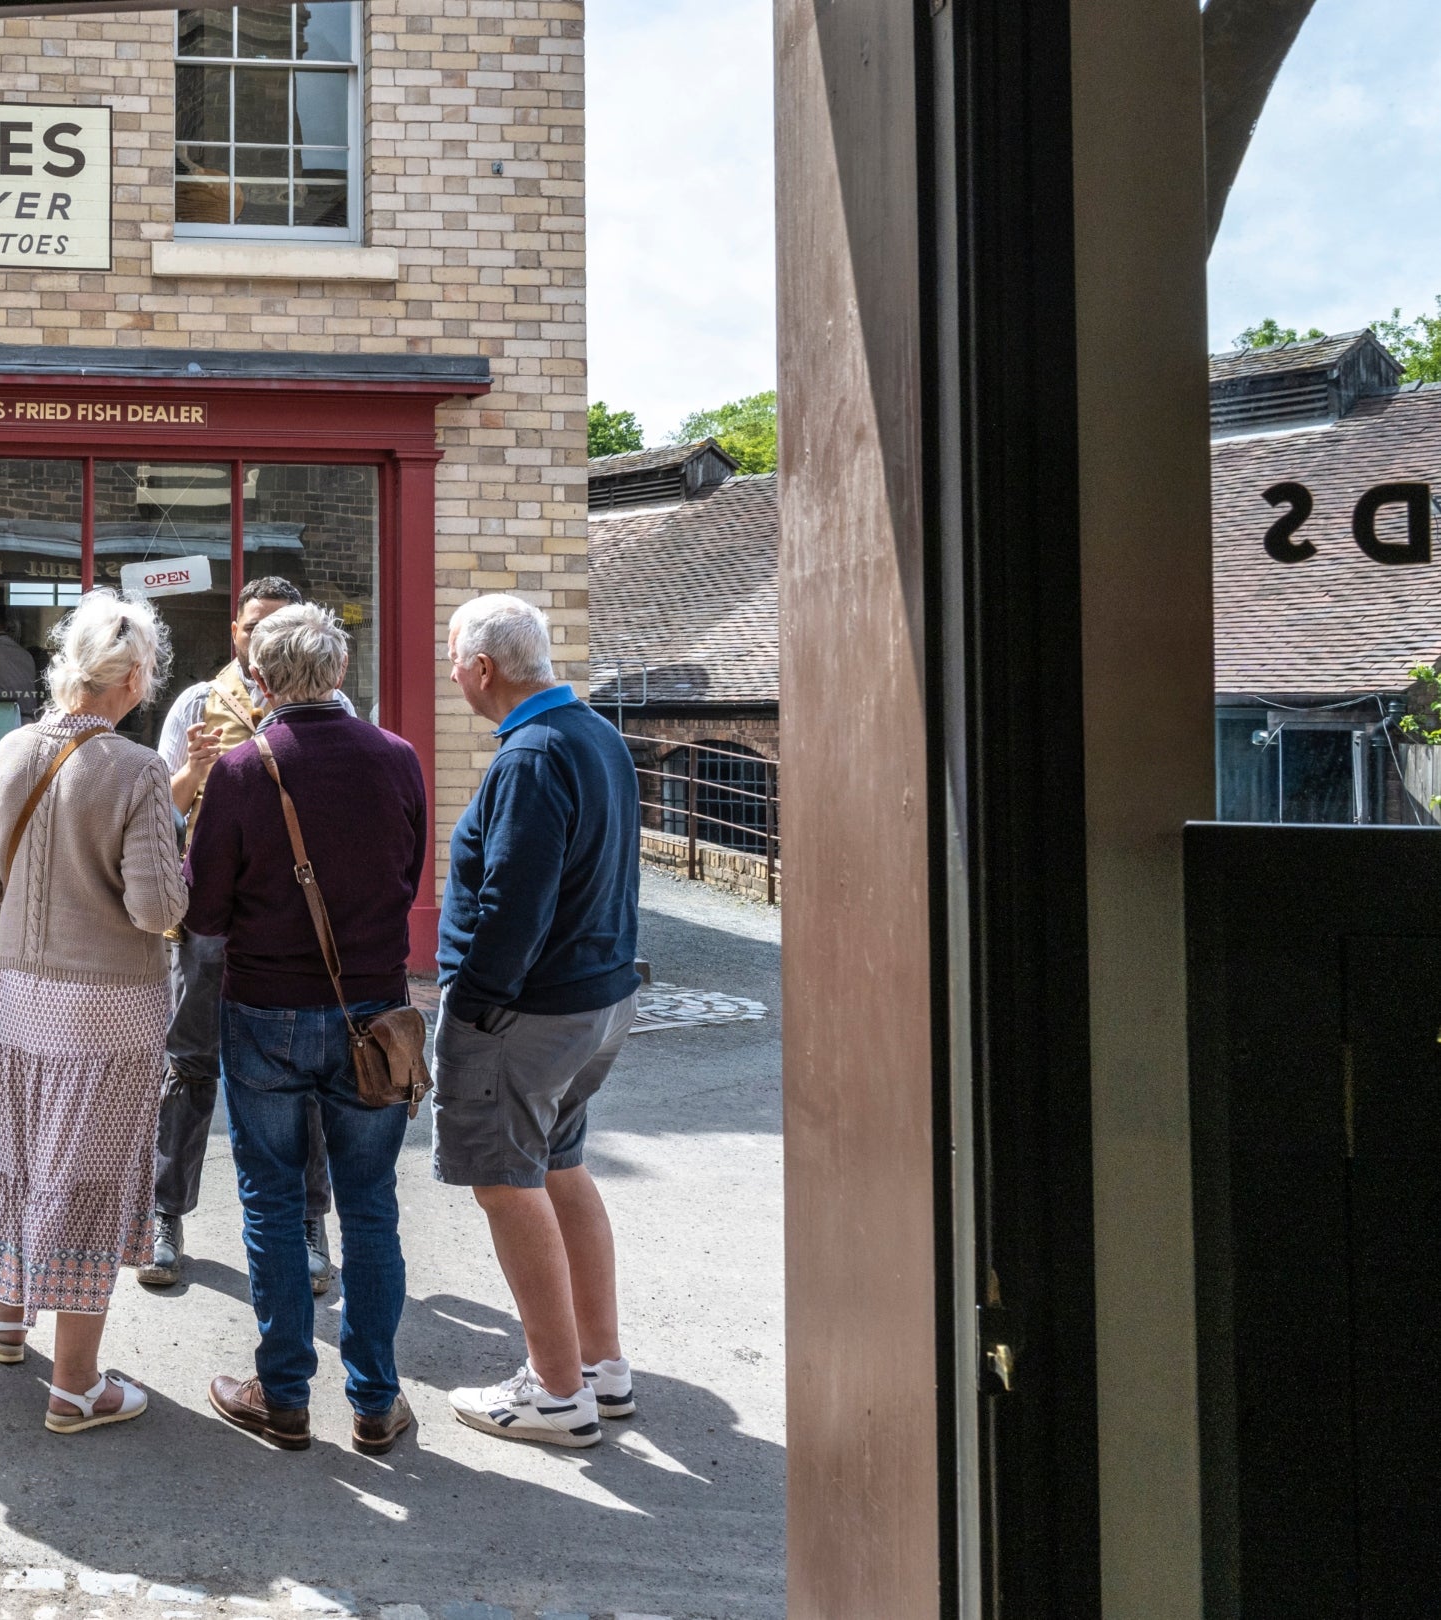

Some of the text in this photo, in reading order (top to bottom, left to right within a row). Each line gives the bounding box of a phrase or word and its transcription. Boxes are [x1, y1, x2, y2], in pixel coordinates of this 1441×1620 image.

[77, 403, 121, 422] FISH
[127, 404, 205, 424] DEALER
[144, 570, 190, 585] OPEN
